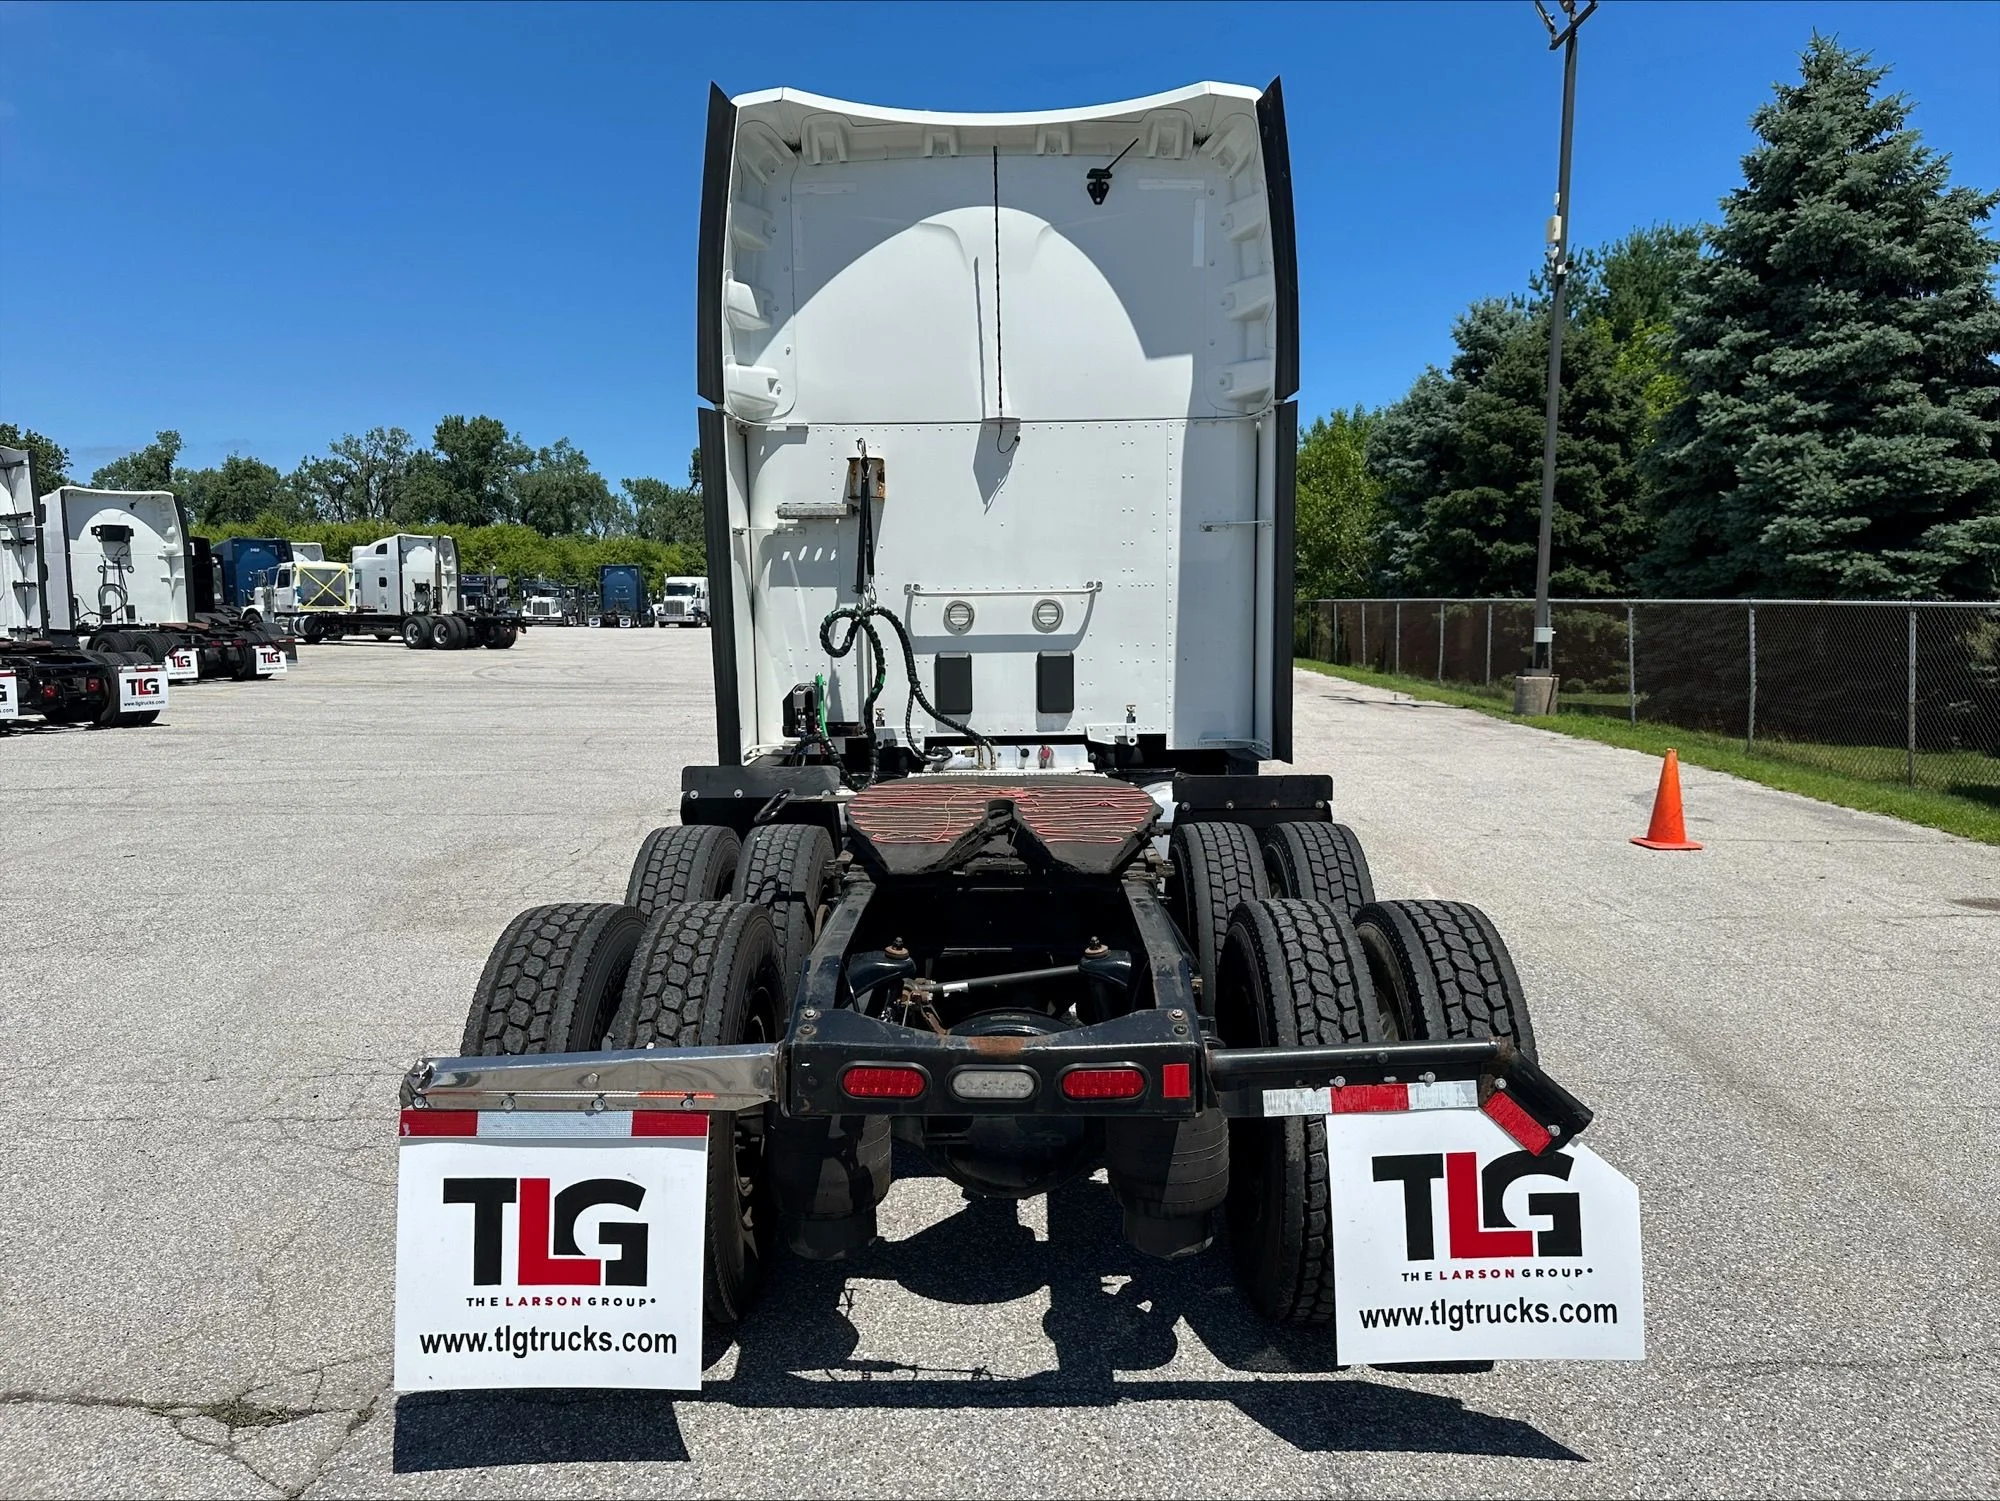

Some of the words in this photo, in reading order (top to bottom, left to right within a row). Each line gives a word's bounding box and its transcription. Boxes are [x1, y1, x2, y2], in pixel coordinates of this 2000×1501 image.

[169, 655, 192, 668] TLG
[260, 652, 281, 664] TLG
[126, 678, 160, 696] TLG
[1372, 1150, 1583, 1261] TLG
[443, 1177, 649, 1287] TLG
[1401, 1272, 1433, 1282] THE
[1439, 1268, 1515, 1281] LARSON
[466, 1297, 499, 1307] THE
[505, 1296, 581, 1307] LARSON
[1359, 1296, 1618, 1332] www.tlgtrucks.com
[419, 1324, 677, 1359] www.tlgtrucks.com
